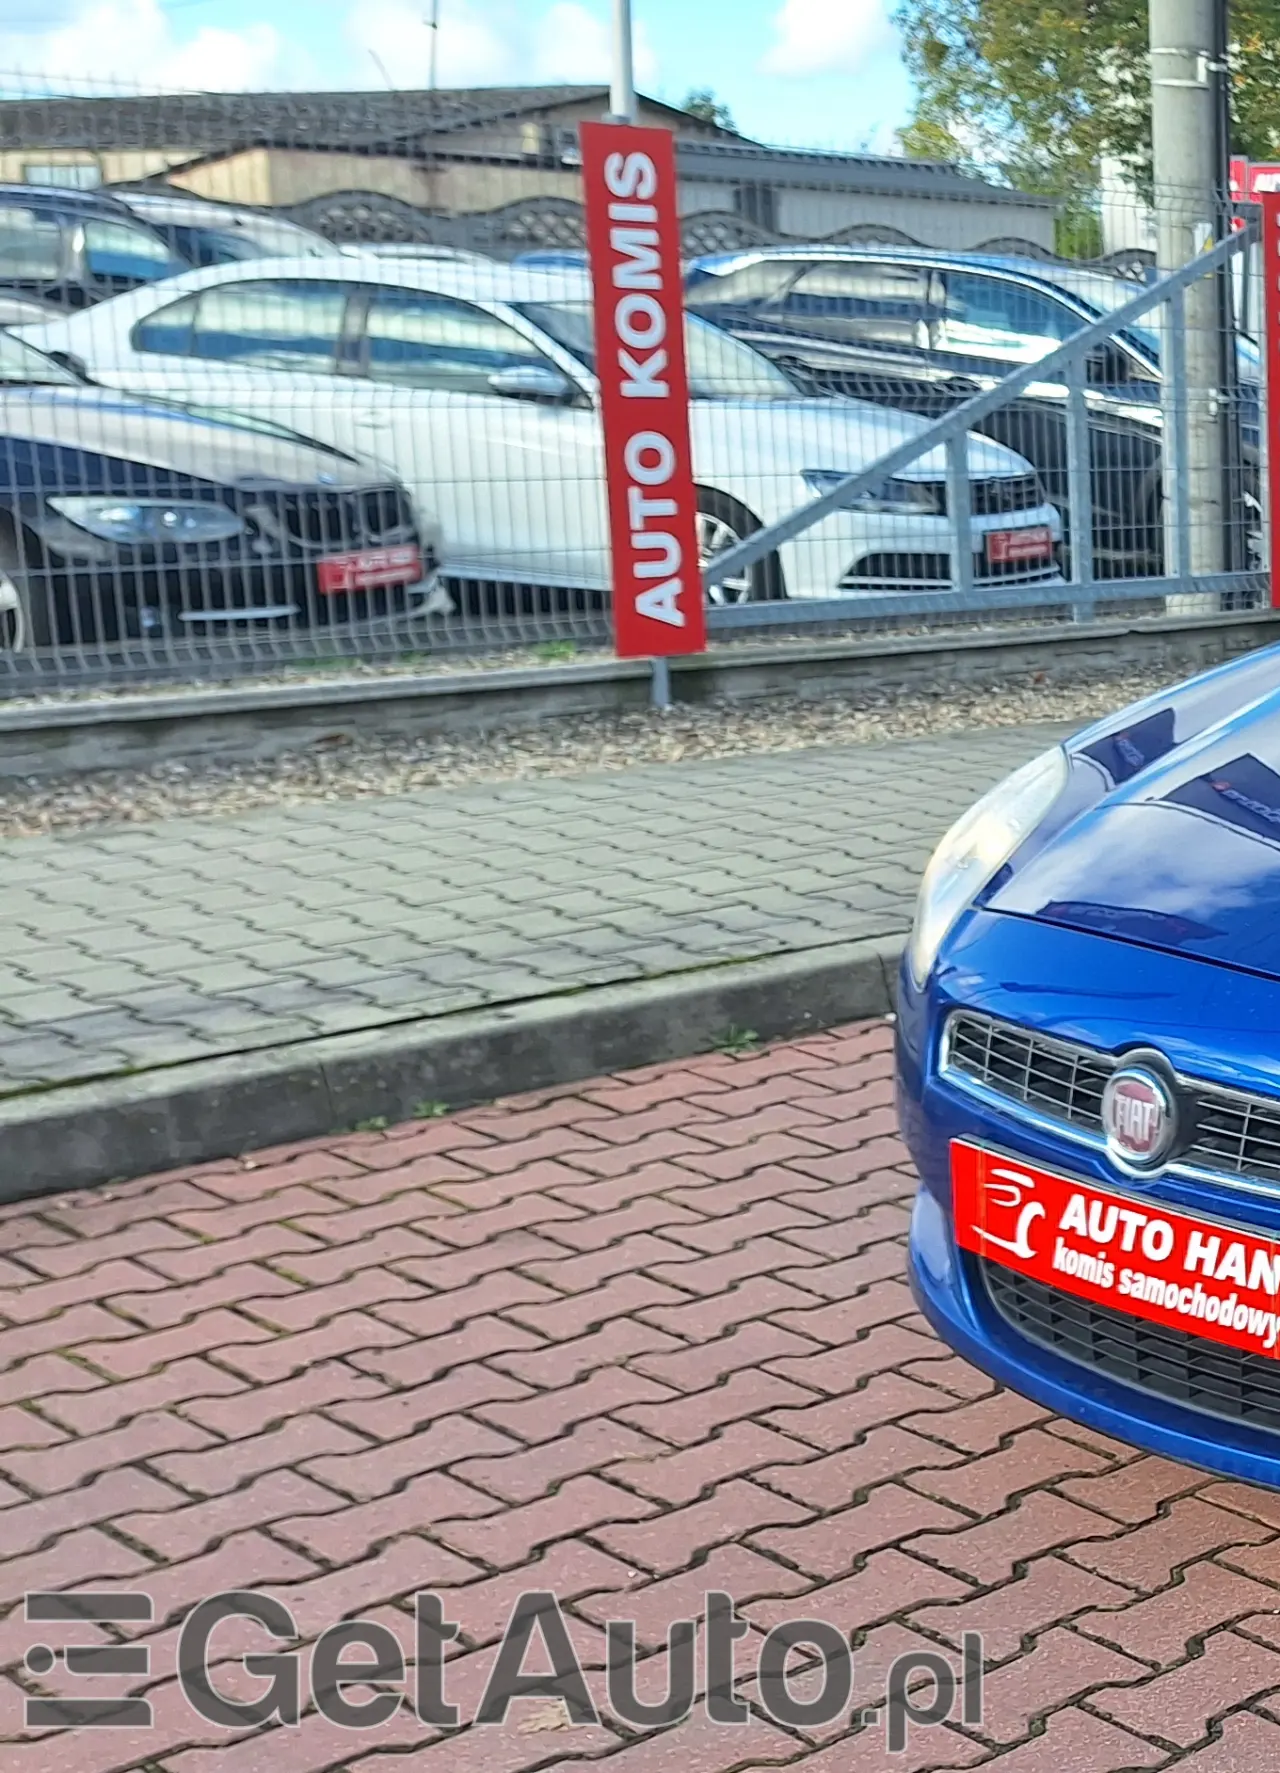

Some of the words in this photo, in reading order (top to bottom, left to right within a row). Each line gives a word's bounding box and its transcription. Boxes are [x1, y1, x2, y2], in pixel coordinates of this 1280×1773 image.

[604, 151, 670, 398] KOMIS
[624, 430, 687, 628] AUTO
[1115, 1092, 1156, 1144] FIAT
[1059, 1193, 1175, 1262] AUTO
[1052, 1236, 1114, 1289] komis
